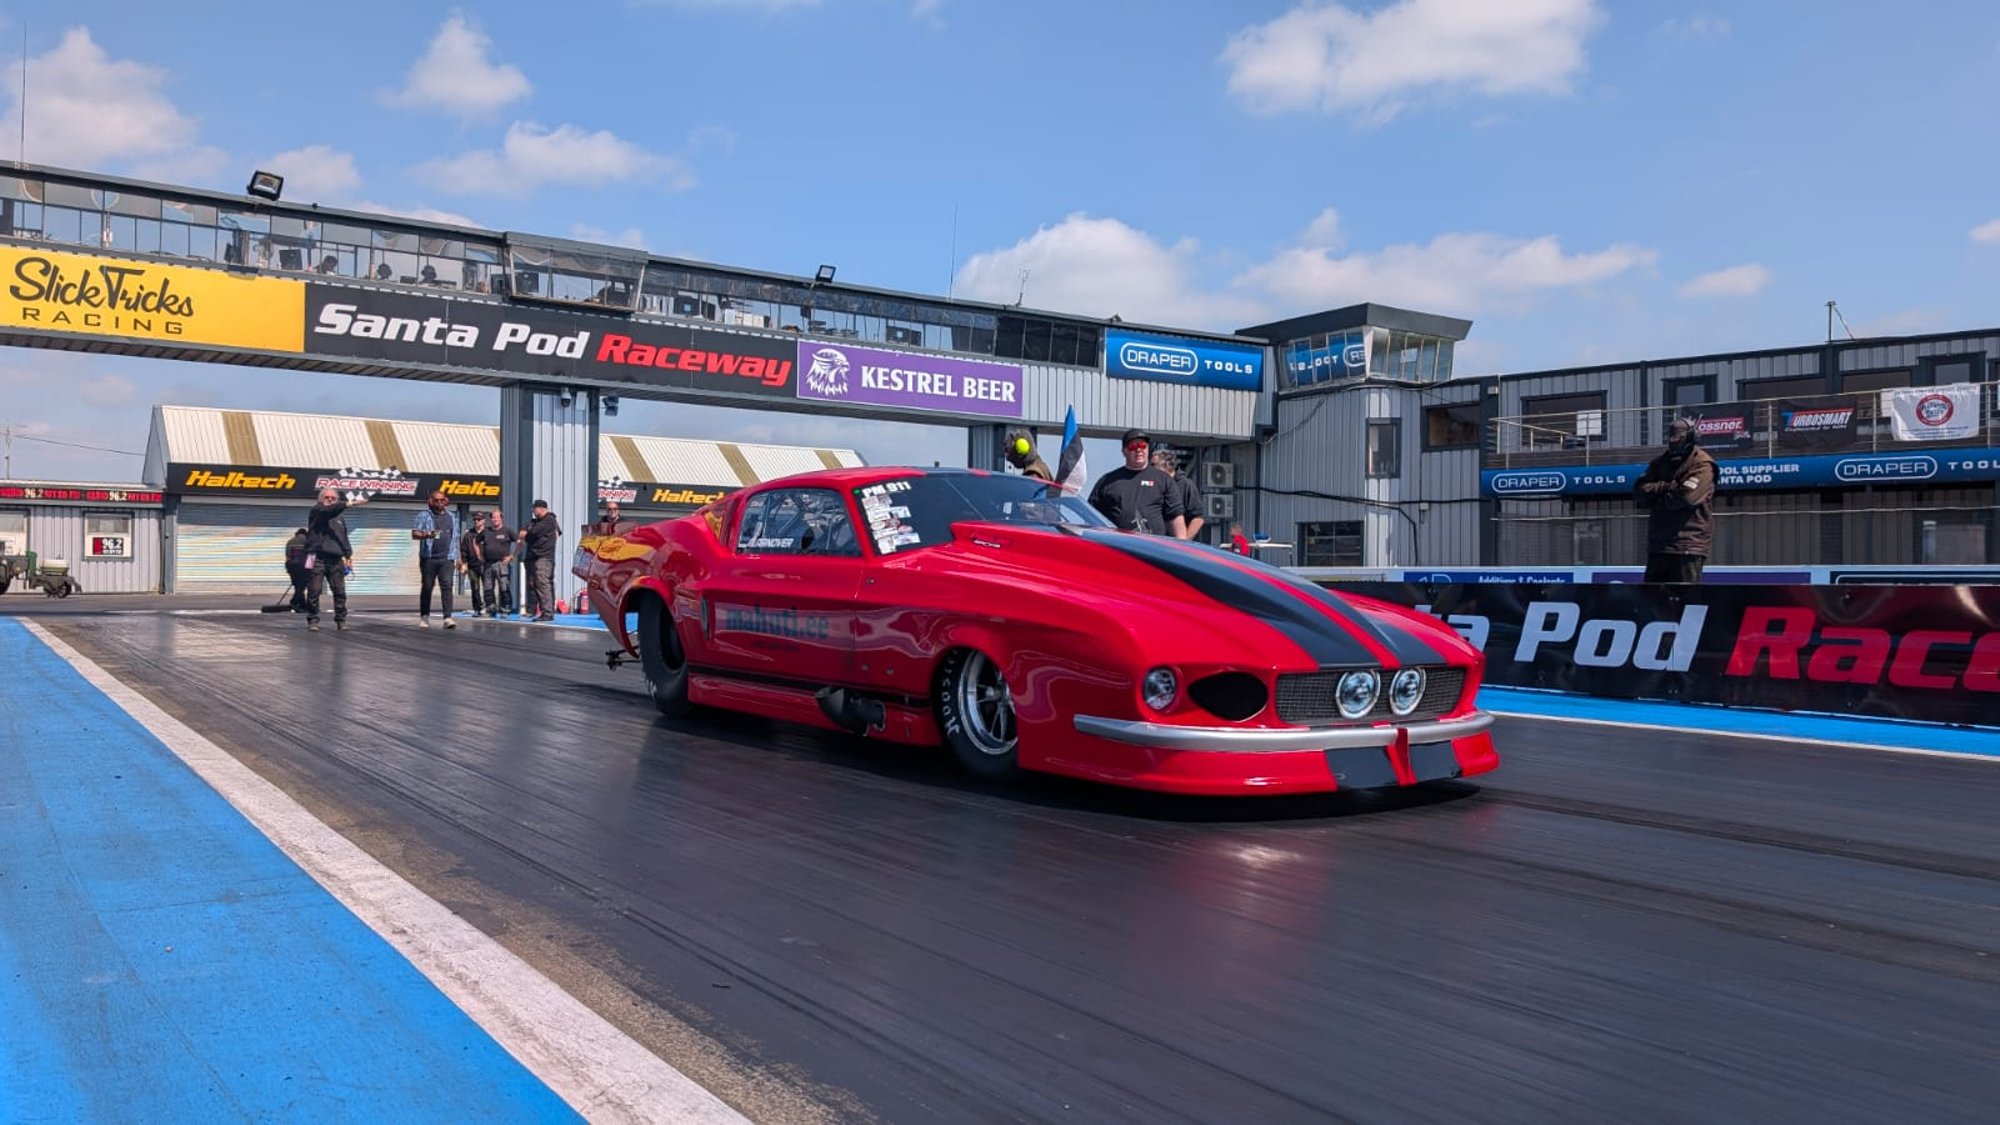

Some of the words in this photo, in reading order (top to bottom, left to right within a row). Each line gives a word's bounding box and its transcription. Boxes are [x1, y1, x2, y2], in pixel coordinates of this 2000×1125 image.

[23, 307, 183, 334] RACING
[314, 303, 479, 348] Santa
[492, 323, 590, 359] Pod
[596, 333, 792, 387] Raceway
[1127, 350, 1191, 368] DRAPER
[1204, 360, 1253, 374] TOOLS
[861, 366, 958, 397] KESTREL
[963, 377, 1016, 402] BEER
[1781, 410, 1853, 431] TURBOSMART
[1741, 464, 1800, 474] SUPPLIER
[1844, 462, 1929, 476] DRAPER
[186, 470, 296, 489] Haltech
[316, 478, 358, 489] RACE
[357, 480, 415, 490] WINNING
[1498, 477, 1560, 488] DRAPER
[1573, 475, 1626, 485] TOOLS
[1746, 475, 1772, 483] POD
[109, 491, 127, 501] 96.2
[862, 485, 886, 497] PM
[886, 481, 911, 491] 911
[102, 538, 121, 549] 96.2
[1514, 601, 1708, 672] Pod
